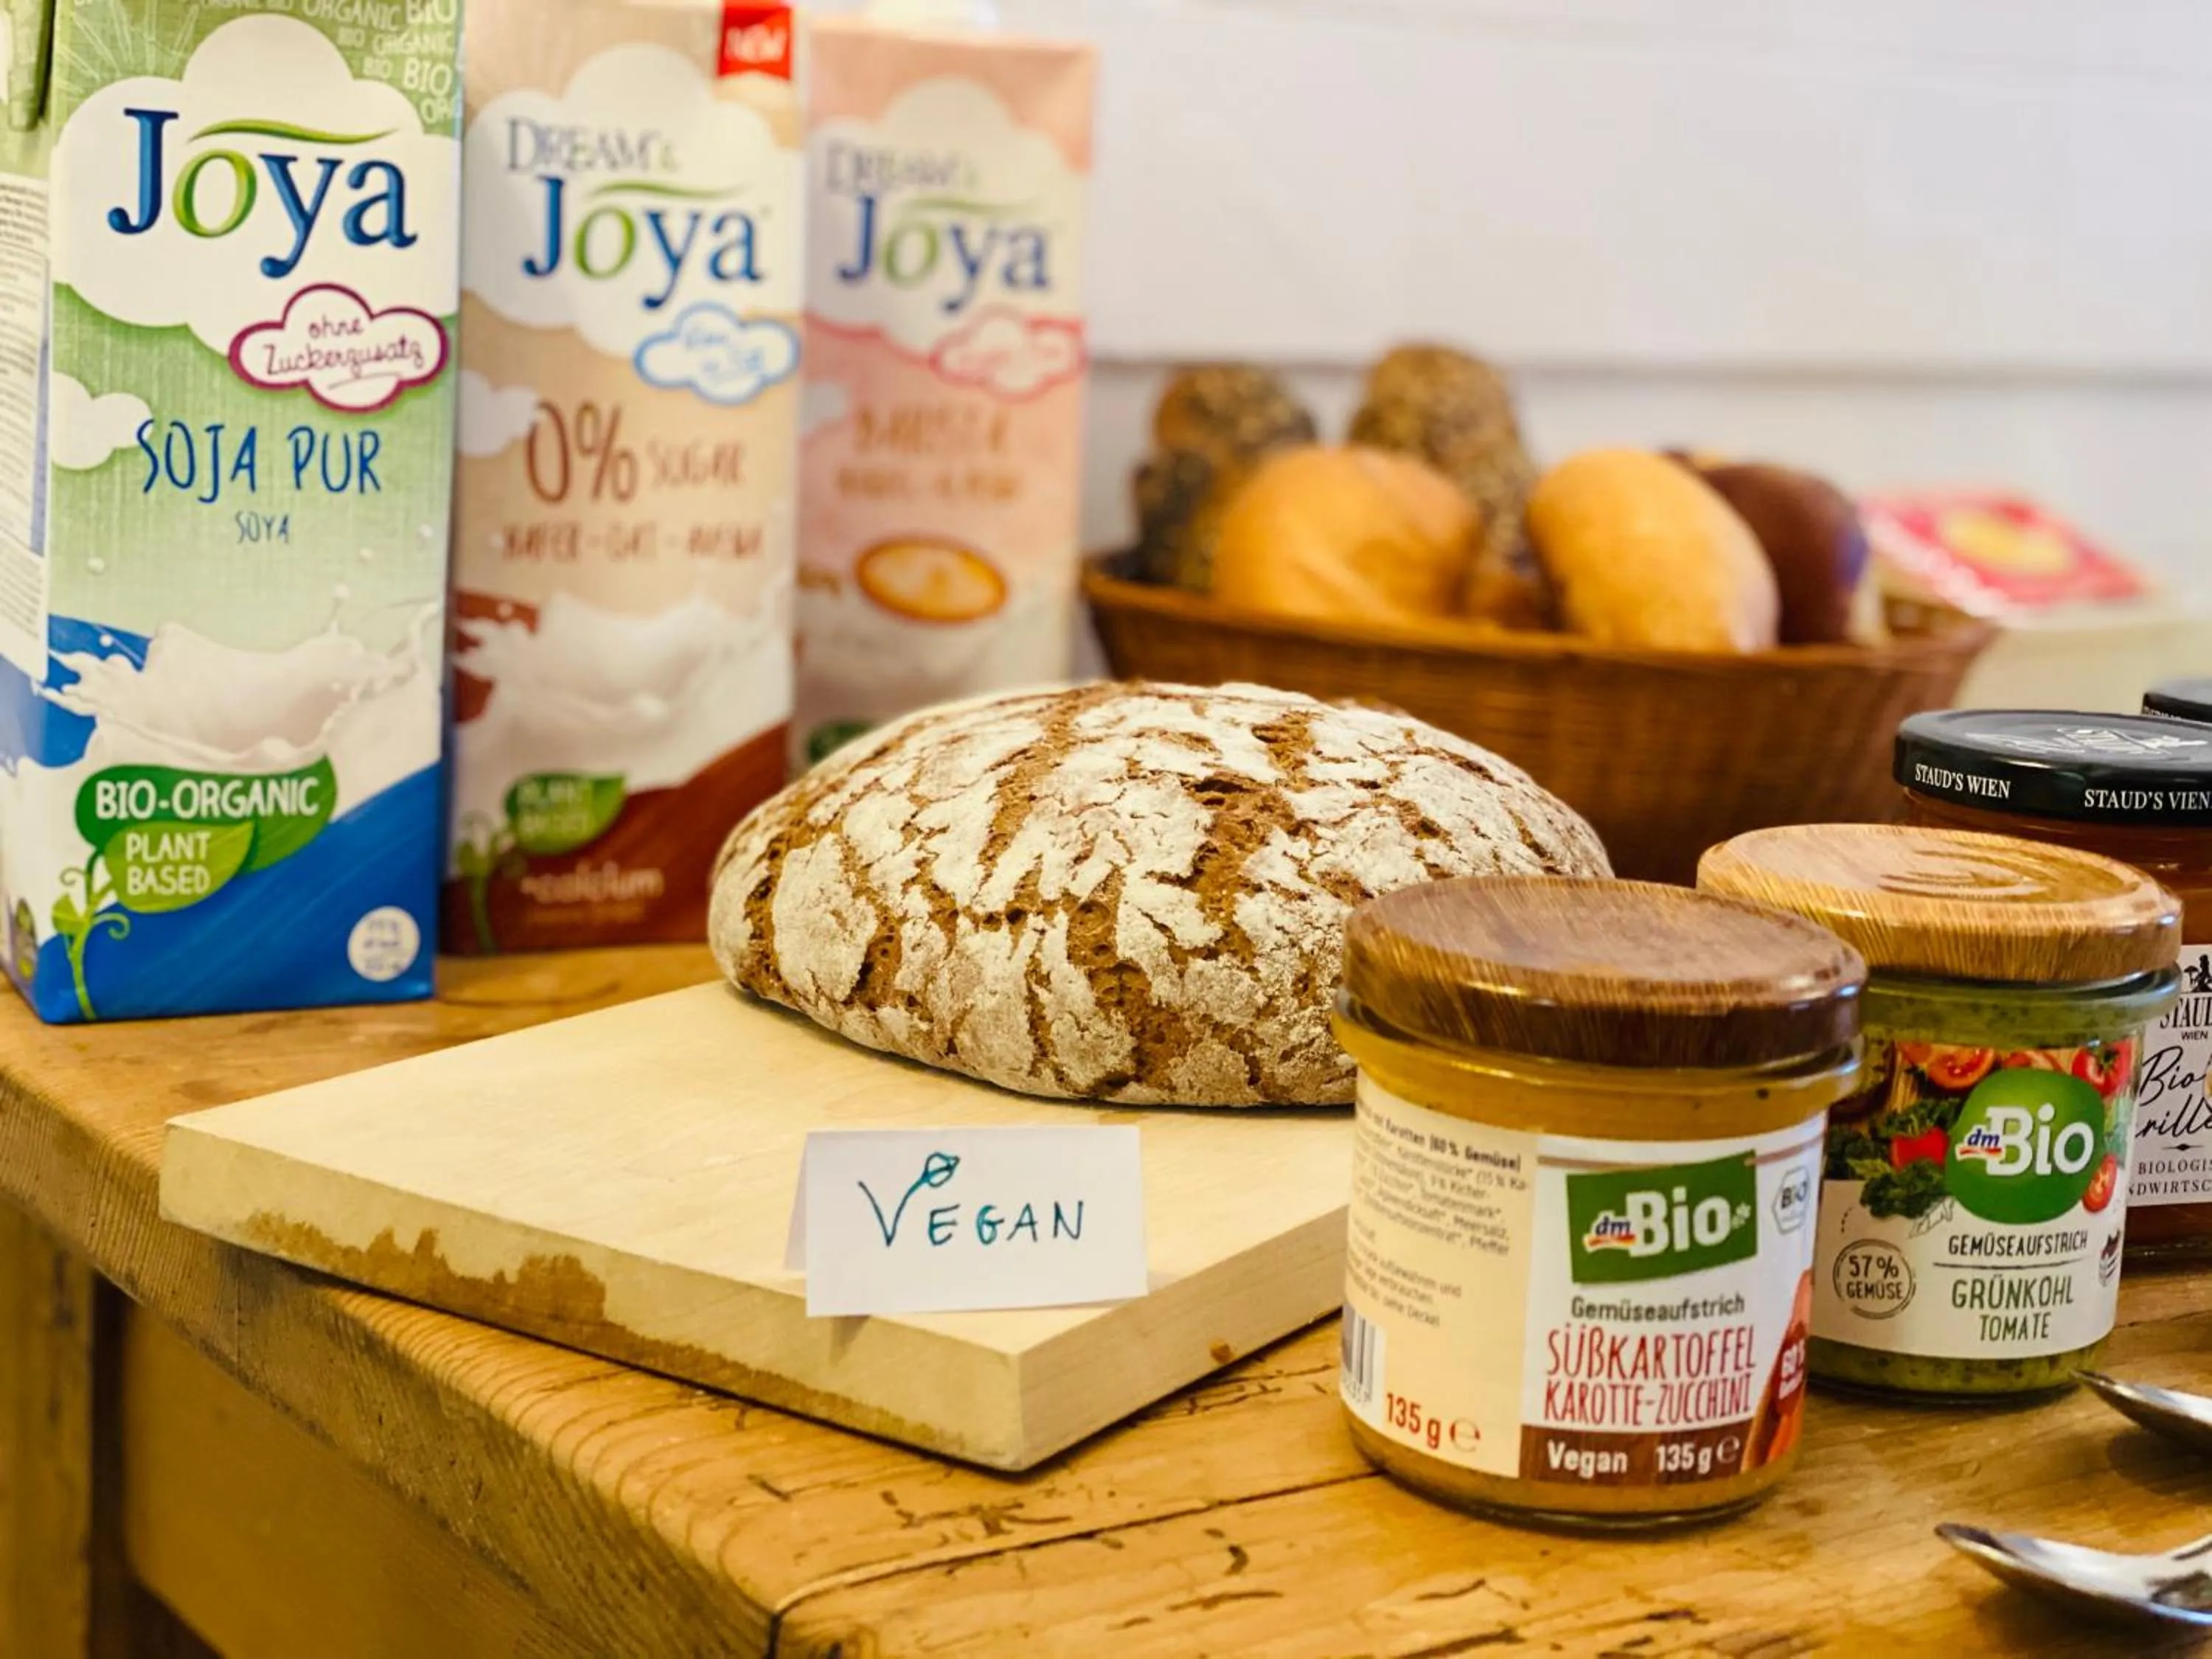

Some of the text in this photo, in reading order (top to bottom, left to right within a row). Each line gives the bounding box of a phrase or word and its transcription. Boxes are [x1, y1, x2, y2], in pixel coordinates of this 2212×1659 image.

[403, 57, 452, 97] BIO
[107, 108, 418, 279] Joya
[522, 175, 765, 310] Joya
[836, 195, 1050, 316] Joya
[308, 313, 364, 338] ohne
[262, 334, 424, 379] Zuckerzusatz
[136, 419, 381, 504] SOJA PUR
[526, 397, 639, 506] 0%
[234, 512, 290, 543] SOYA
[95, 777, 320, 821] BIO-ORGANIC
[1915, 762, 2011, 799] STAUD'S WIEN
[2084, 789, 2212, 810] STAUD'S VIEN
[125, 831, 212, 863] PLANT
[126, 864, 211, 896] BASED
[2181, 1031, 2208, 1041] WIEN
[2138, 1045, 2206, 1107] Bio
[2138, 1158, 2212, 1175] BIOLOGI
[1948, 1231, 2087, 1256] GEMÜSEAUFSTRICH
[1571, 1291, 1745, 1323] Gemüseaufstrich
[1951, 1273, 2074, 1310] GRÜNKOHL
[1980, 1312, 2052, 1342] TOMATE
[1548, 1439, 1627, 1479] Vegan
